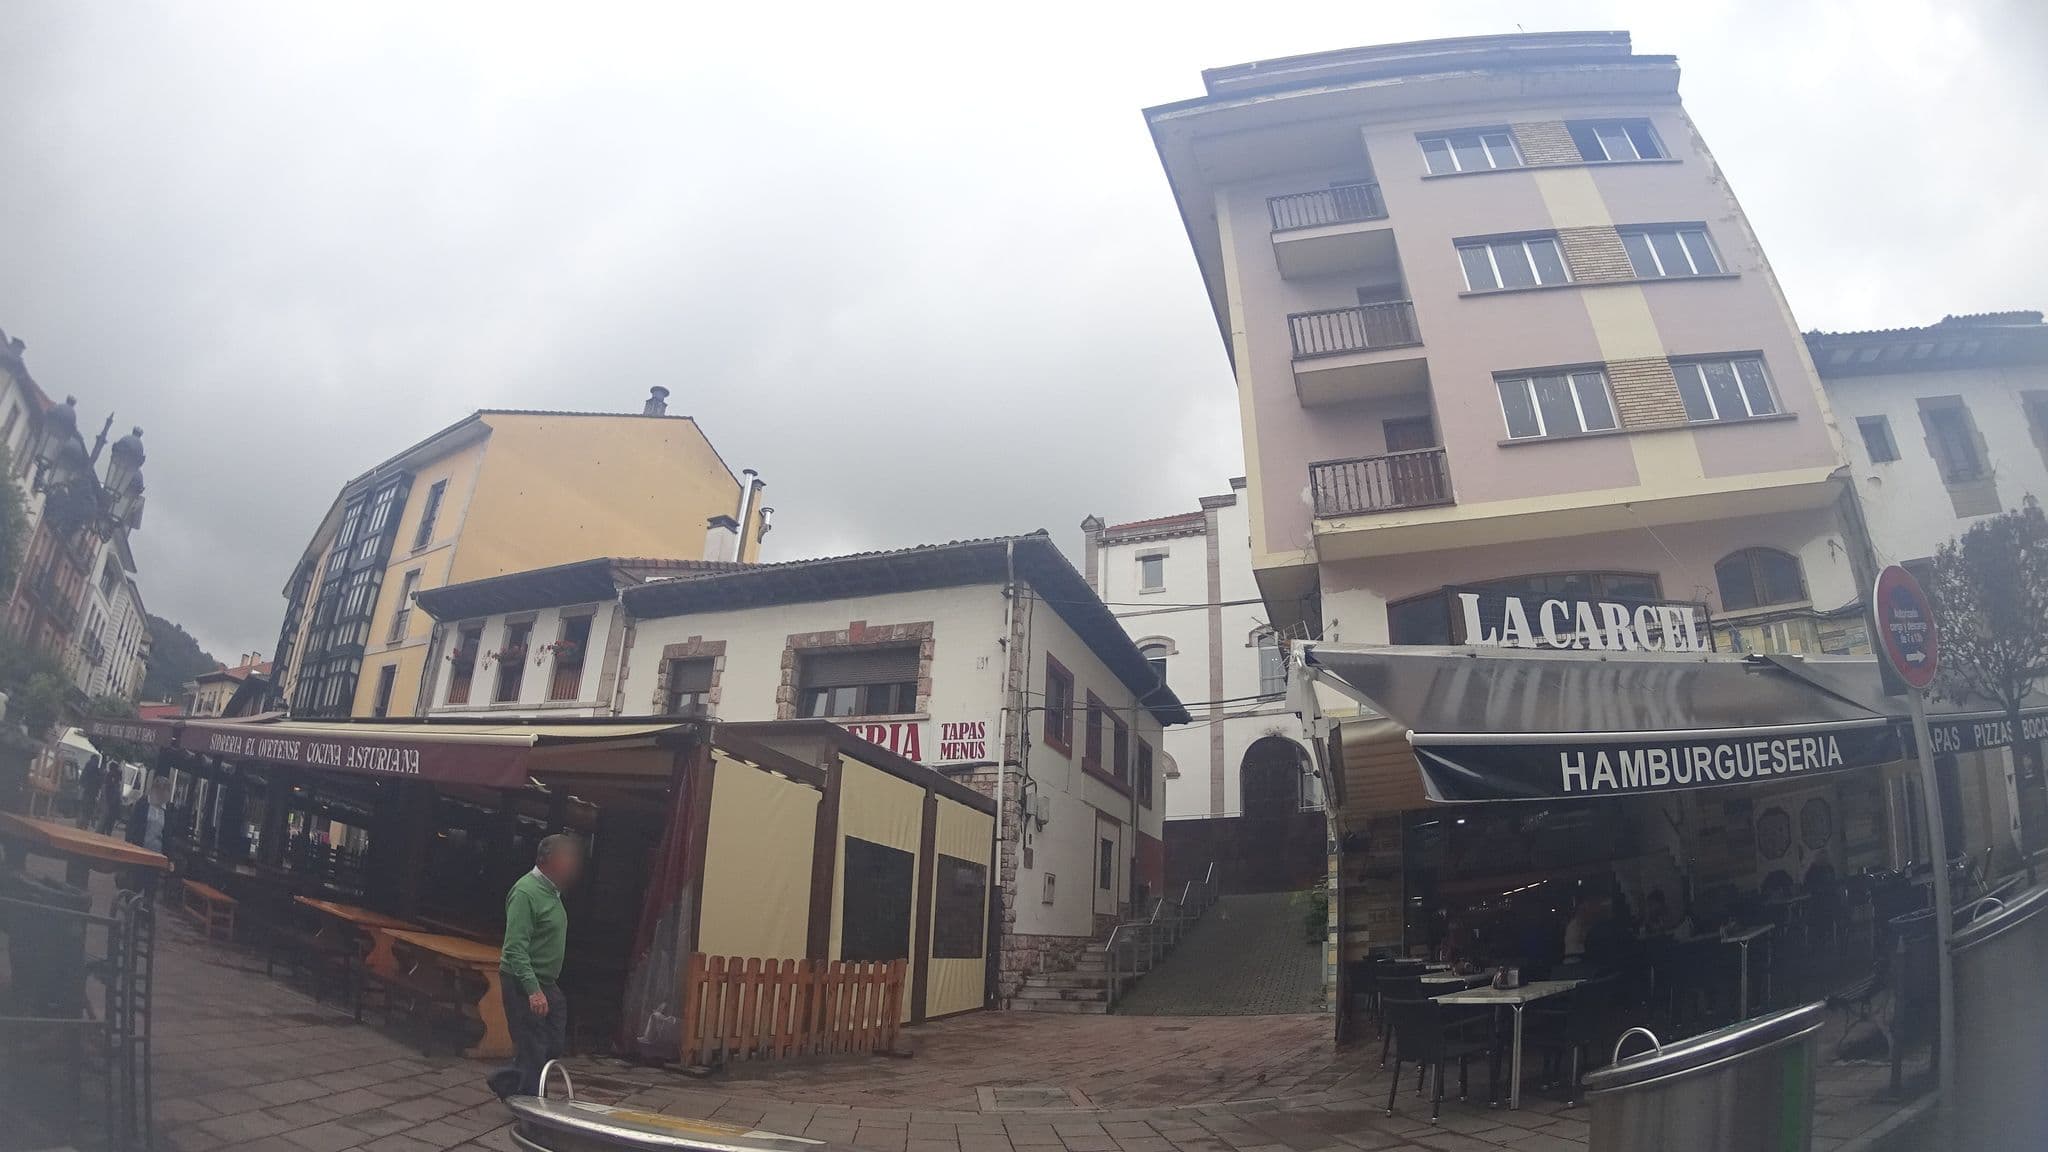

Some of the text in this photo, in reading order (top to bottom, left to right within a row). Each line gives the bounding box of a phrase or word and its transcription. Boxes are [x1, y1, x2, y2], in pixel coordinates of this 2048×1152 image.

[1458, 593, 1708, 652] LA CARCEL
[941, 721, 985, 741] TAPAS
[1973, 721, 2013, 748] PIZZAS
[2021, 716, 2048, 740] BOCA
[209, 733, 242, 754] SIDRERIA
[245, 738, 256, 755] EL
[306, 742, 341, 766] COCINA
[346, 745, 419, 774] ASTURIANA
[940, 741, 986, 760] MENUS
[1560, 736, 1843, 792] HAMBURGUESERIA
